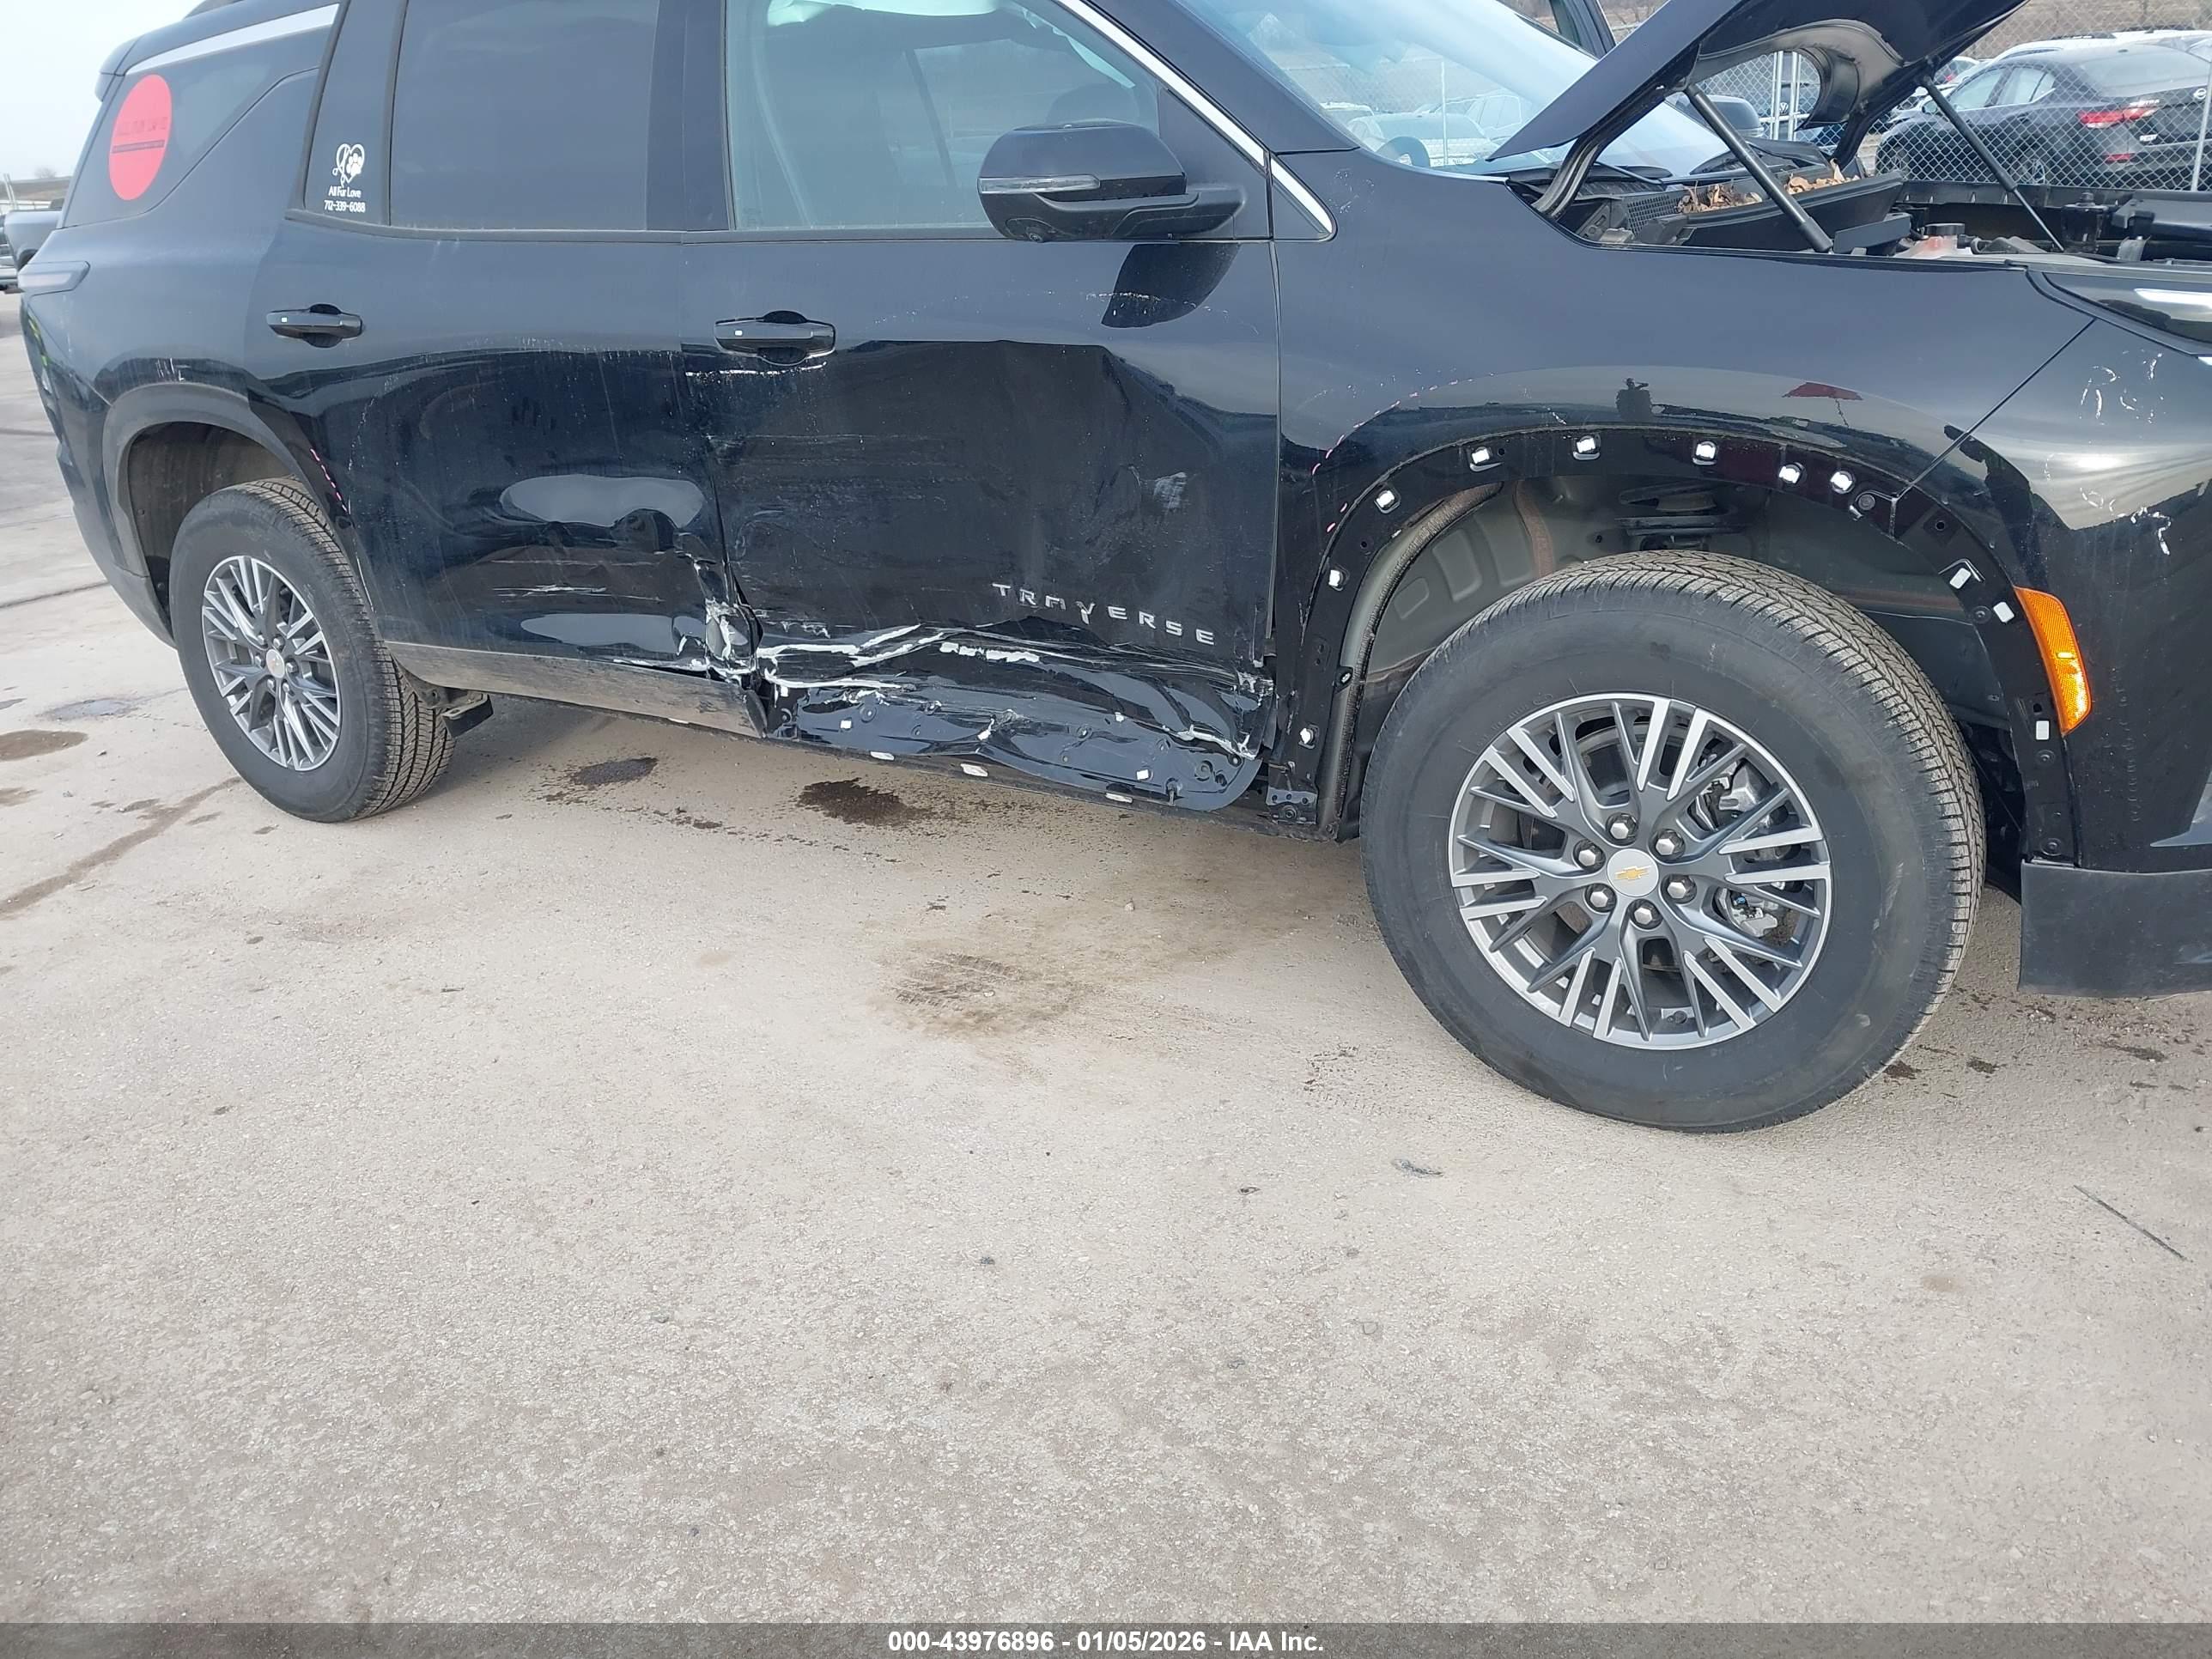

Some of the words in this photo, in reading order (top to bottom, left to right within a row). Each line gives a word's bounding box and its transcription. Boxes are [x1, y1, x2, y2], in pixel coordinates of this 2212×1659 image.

[328, 185, 337, 197] All
[337, 185, 347, 197] Fur
[347, 186, 362, 198] Love
[993, 582, 1215, 646] TRAVERSE
